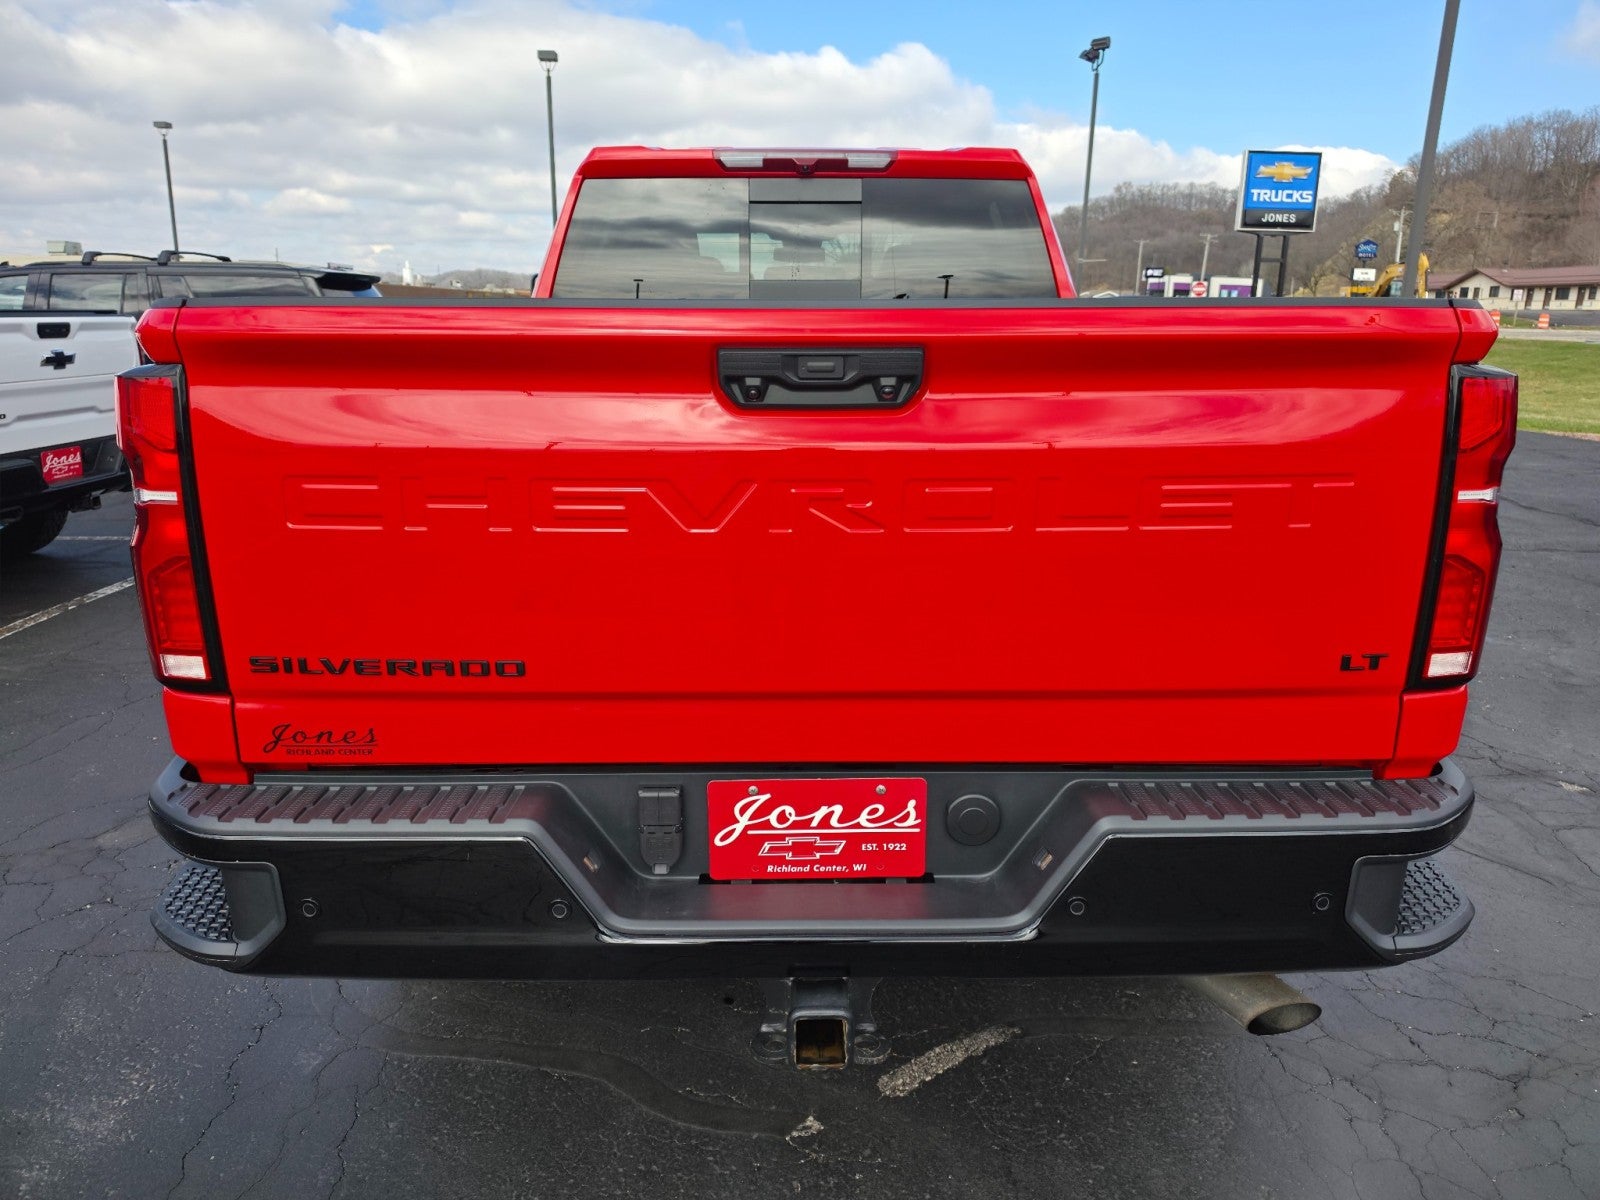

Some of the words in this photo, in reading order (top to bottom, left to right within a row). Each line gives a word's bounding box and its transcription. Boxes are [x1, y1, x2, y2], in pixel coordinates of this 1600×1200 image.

[1250, 188, 1313, 203] TRUCKS
[1261, 213, 1296, 223] JONES
[43, 452, 81, 472] Jones
[282, 474, 1356, 535] CHEVROLET
[249, 656, 526, 677] SILVERADO
[1340, 653, 1389, 672] LT
[262, 724, 378, 753] Jones
[286, 748, 335, 756] RICHLAND
[338, 748, 373, 756] CENTER
[714, 793, 922, 847] Jones
[861, 841, 879, 851] EST.
[882, 841, 907, 851] 1922
[766, 863, 810, 874] Richland
[813, 863, 849, 874] Center,
[852, 863, 867, 874] WI
